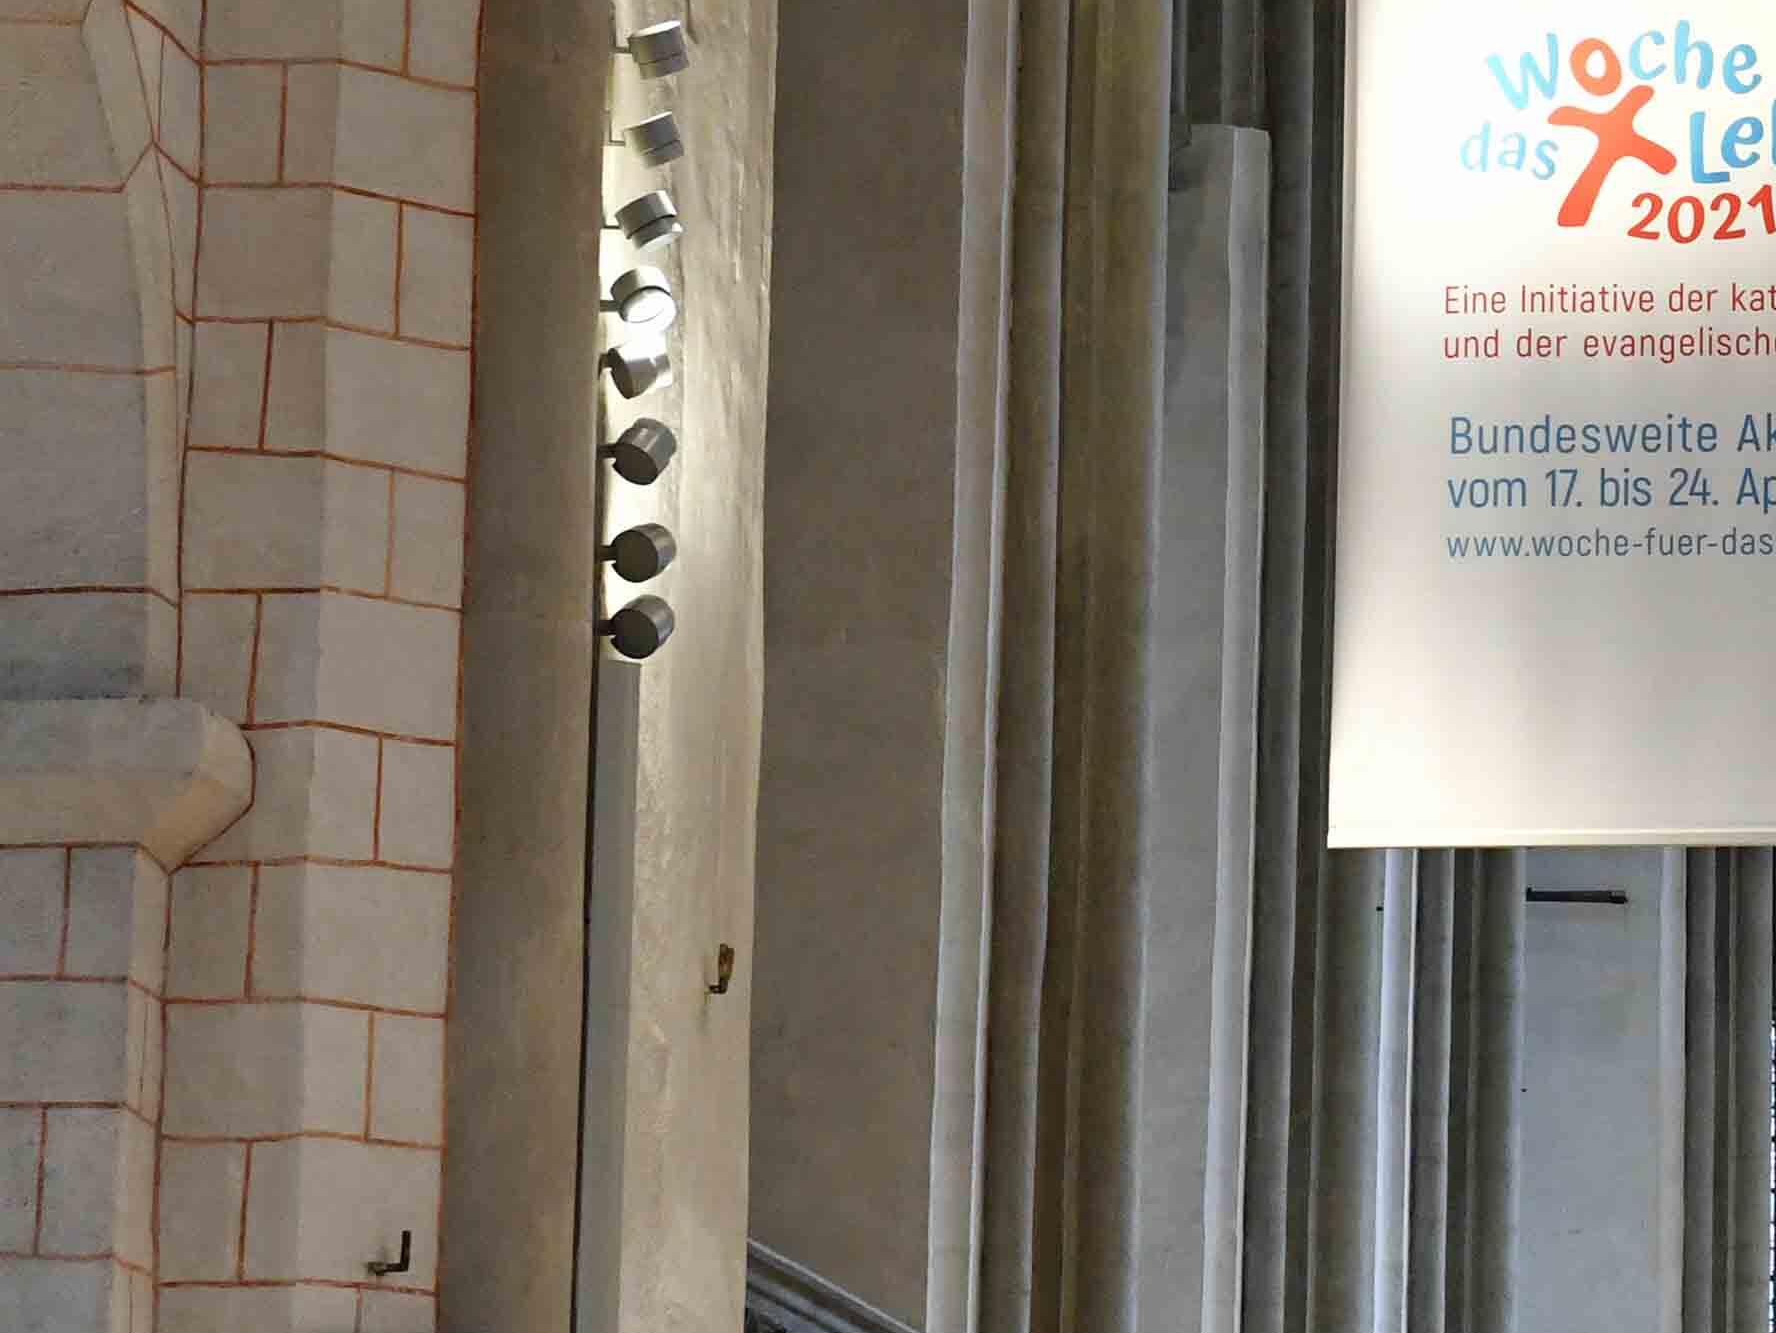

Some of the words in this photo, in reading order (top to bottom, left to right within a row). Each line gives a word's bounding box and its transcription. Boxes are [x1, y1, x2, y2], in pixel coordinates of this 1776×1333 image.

[1485, 19, 1762, 110] Woche
[1459, 120, 1559, 181] das
[1627, 184, 1776, 245] 2021
[1446, 286, 1506, 314] Eine
[1522, 284, 1654, 313] Initiative
[1669, 283, 1718, 312] der
[1445, 329, 1498, 358] und
[1517, 328, 1568, 357] der
[1451, 413, 1717, 454] Bundesweite
[1448, 478, 1526, 508] vom
[1546, 468, 1582, 507] 17.
[1600, 468, 1651, 507] bis
[1669, 468, 1718, 506] 24.
